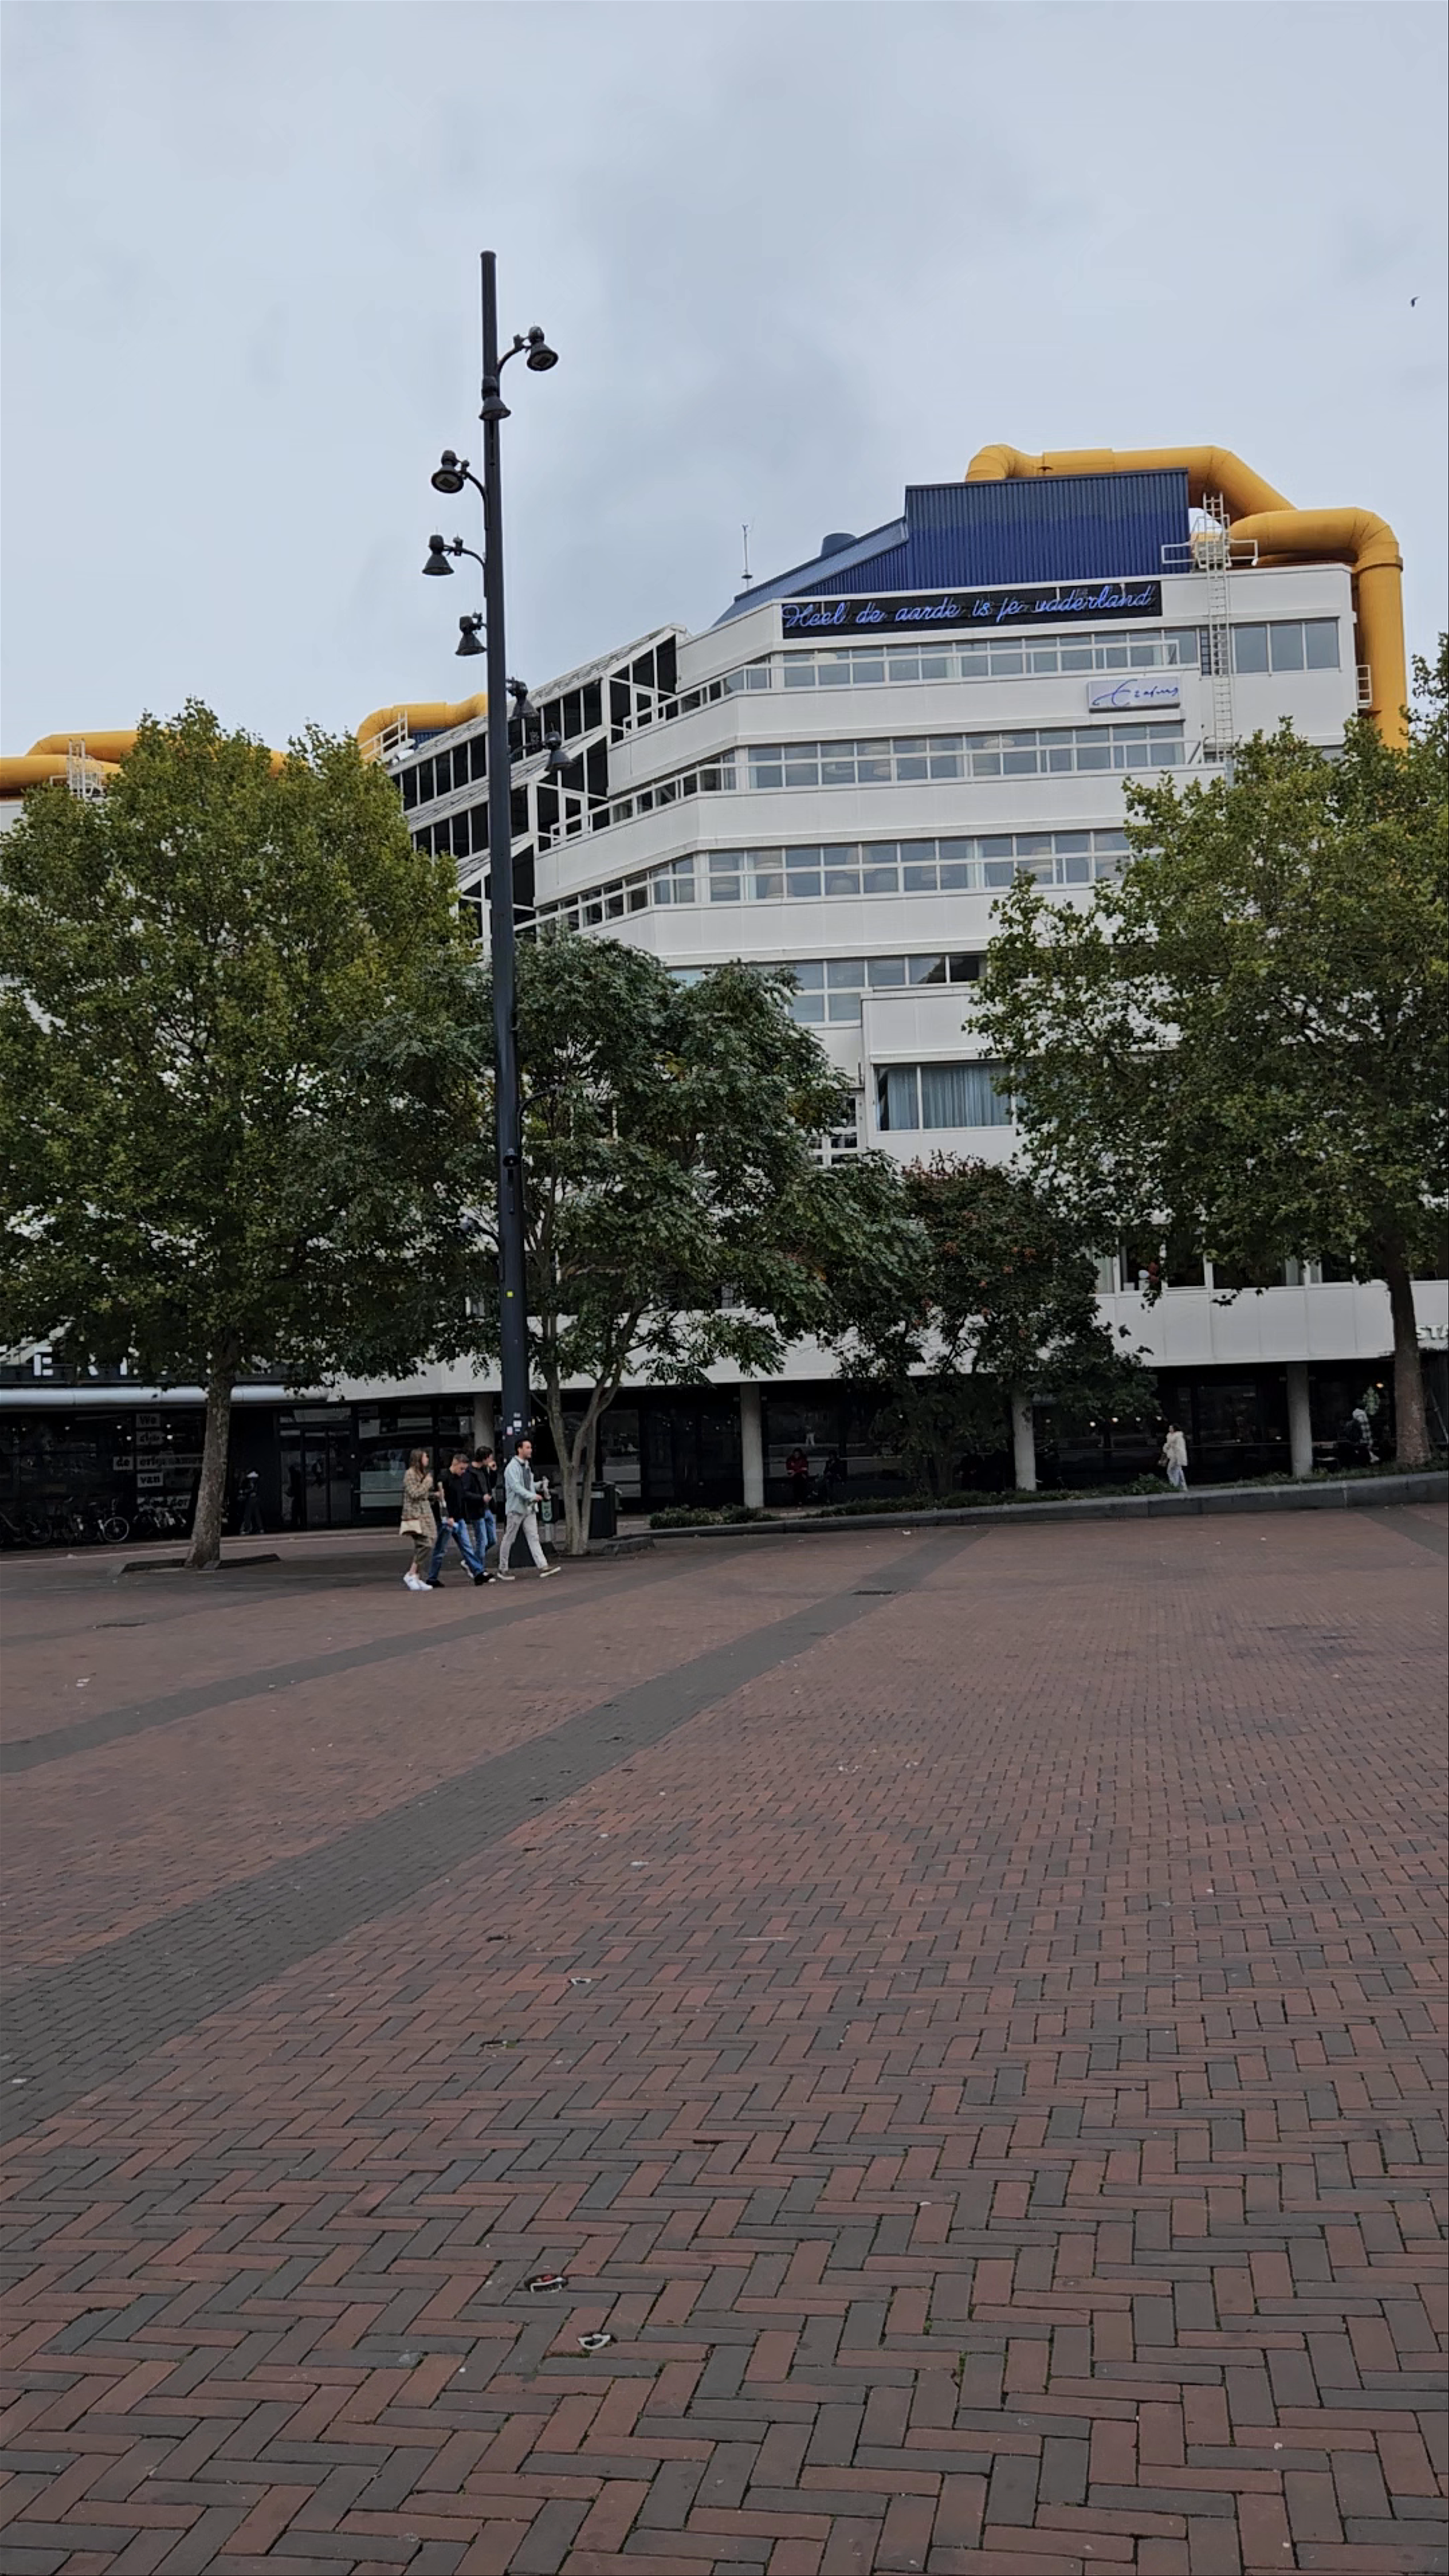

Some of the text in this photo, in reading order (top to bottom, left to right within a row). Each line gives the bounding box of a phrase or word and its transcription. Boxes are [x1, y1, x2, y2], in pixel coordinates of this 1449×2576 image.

[782, 585, 1152, 627] Heel de aarde is je vaderland
